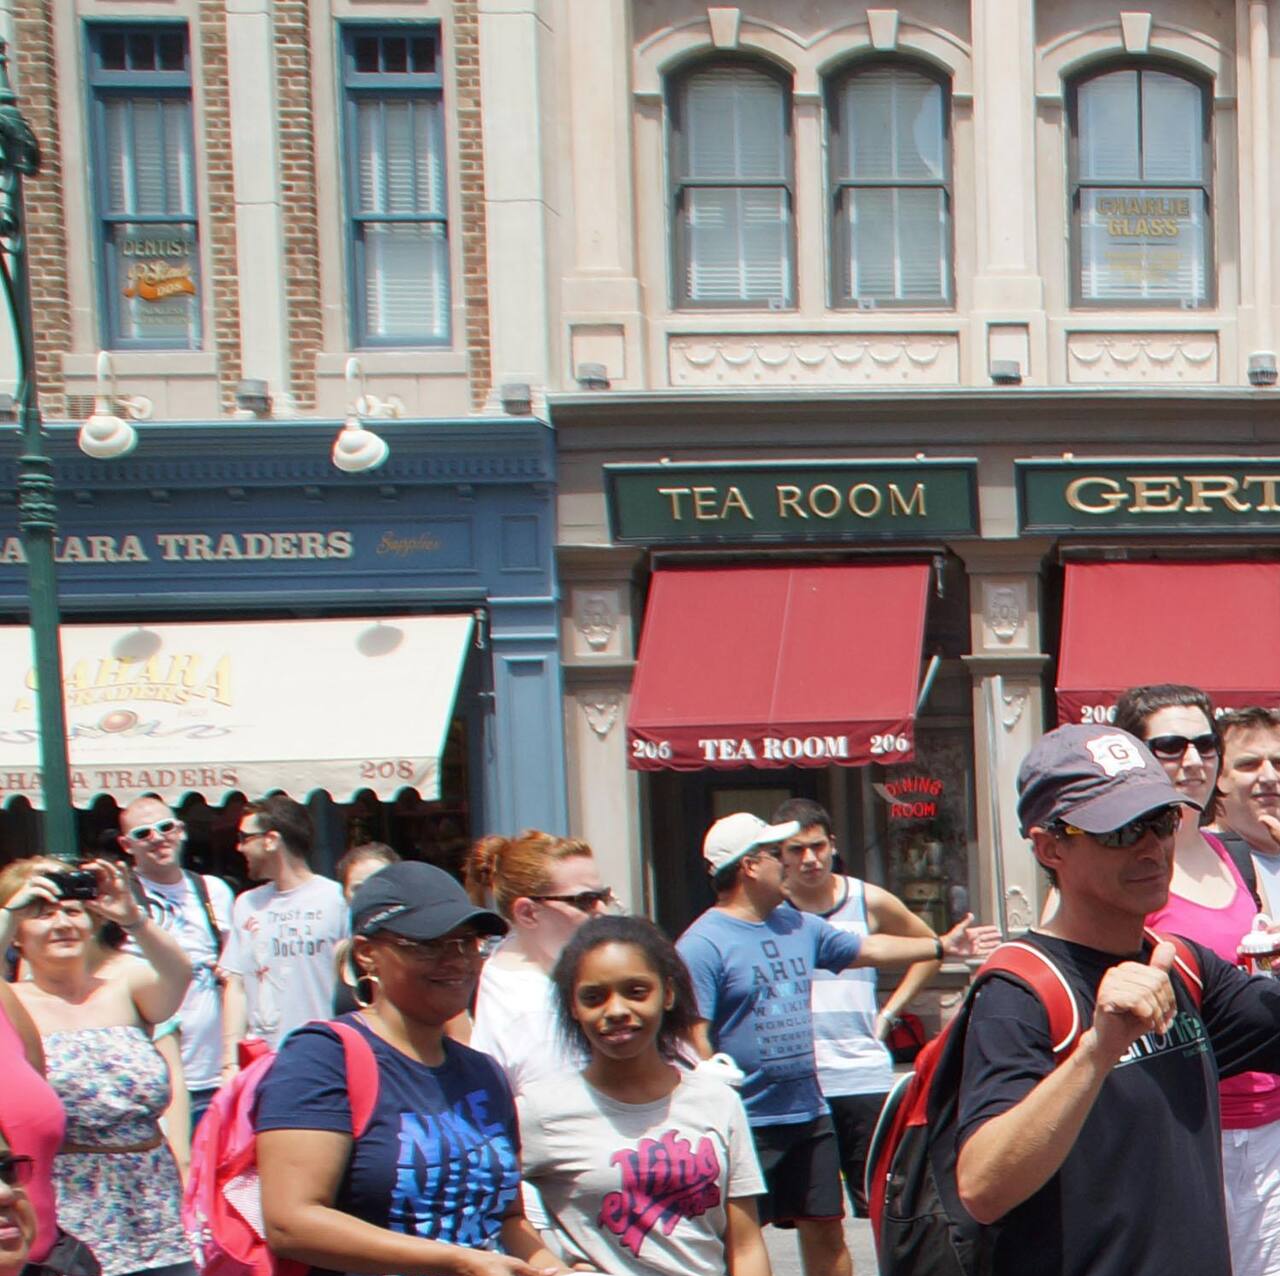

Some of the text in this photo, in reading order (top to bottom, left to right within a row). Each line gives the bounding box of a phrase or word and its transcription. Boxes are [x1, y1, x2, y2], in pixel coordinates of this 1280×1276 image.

[1096, 197, 1189, 215] CHARLIE
[1107, 218, 1178, 236] GLASS
[123, 240, 191, 256] DENTIST
[658, 483, 928, 520] TEA ROOM
[0, 531, 352, 564] AARA TRADERS
[632, 733, 909, 761] 206 TEA ROOM 206
[95, 767, 240, 788] TRADERS
[360, 760, 414, 780] 208
[884, 776, 944, 797] DINING
[891, 802, 937, 818] ROOM
[272, 937, 326, 957] Doctor
